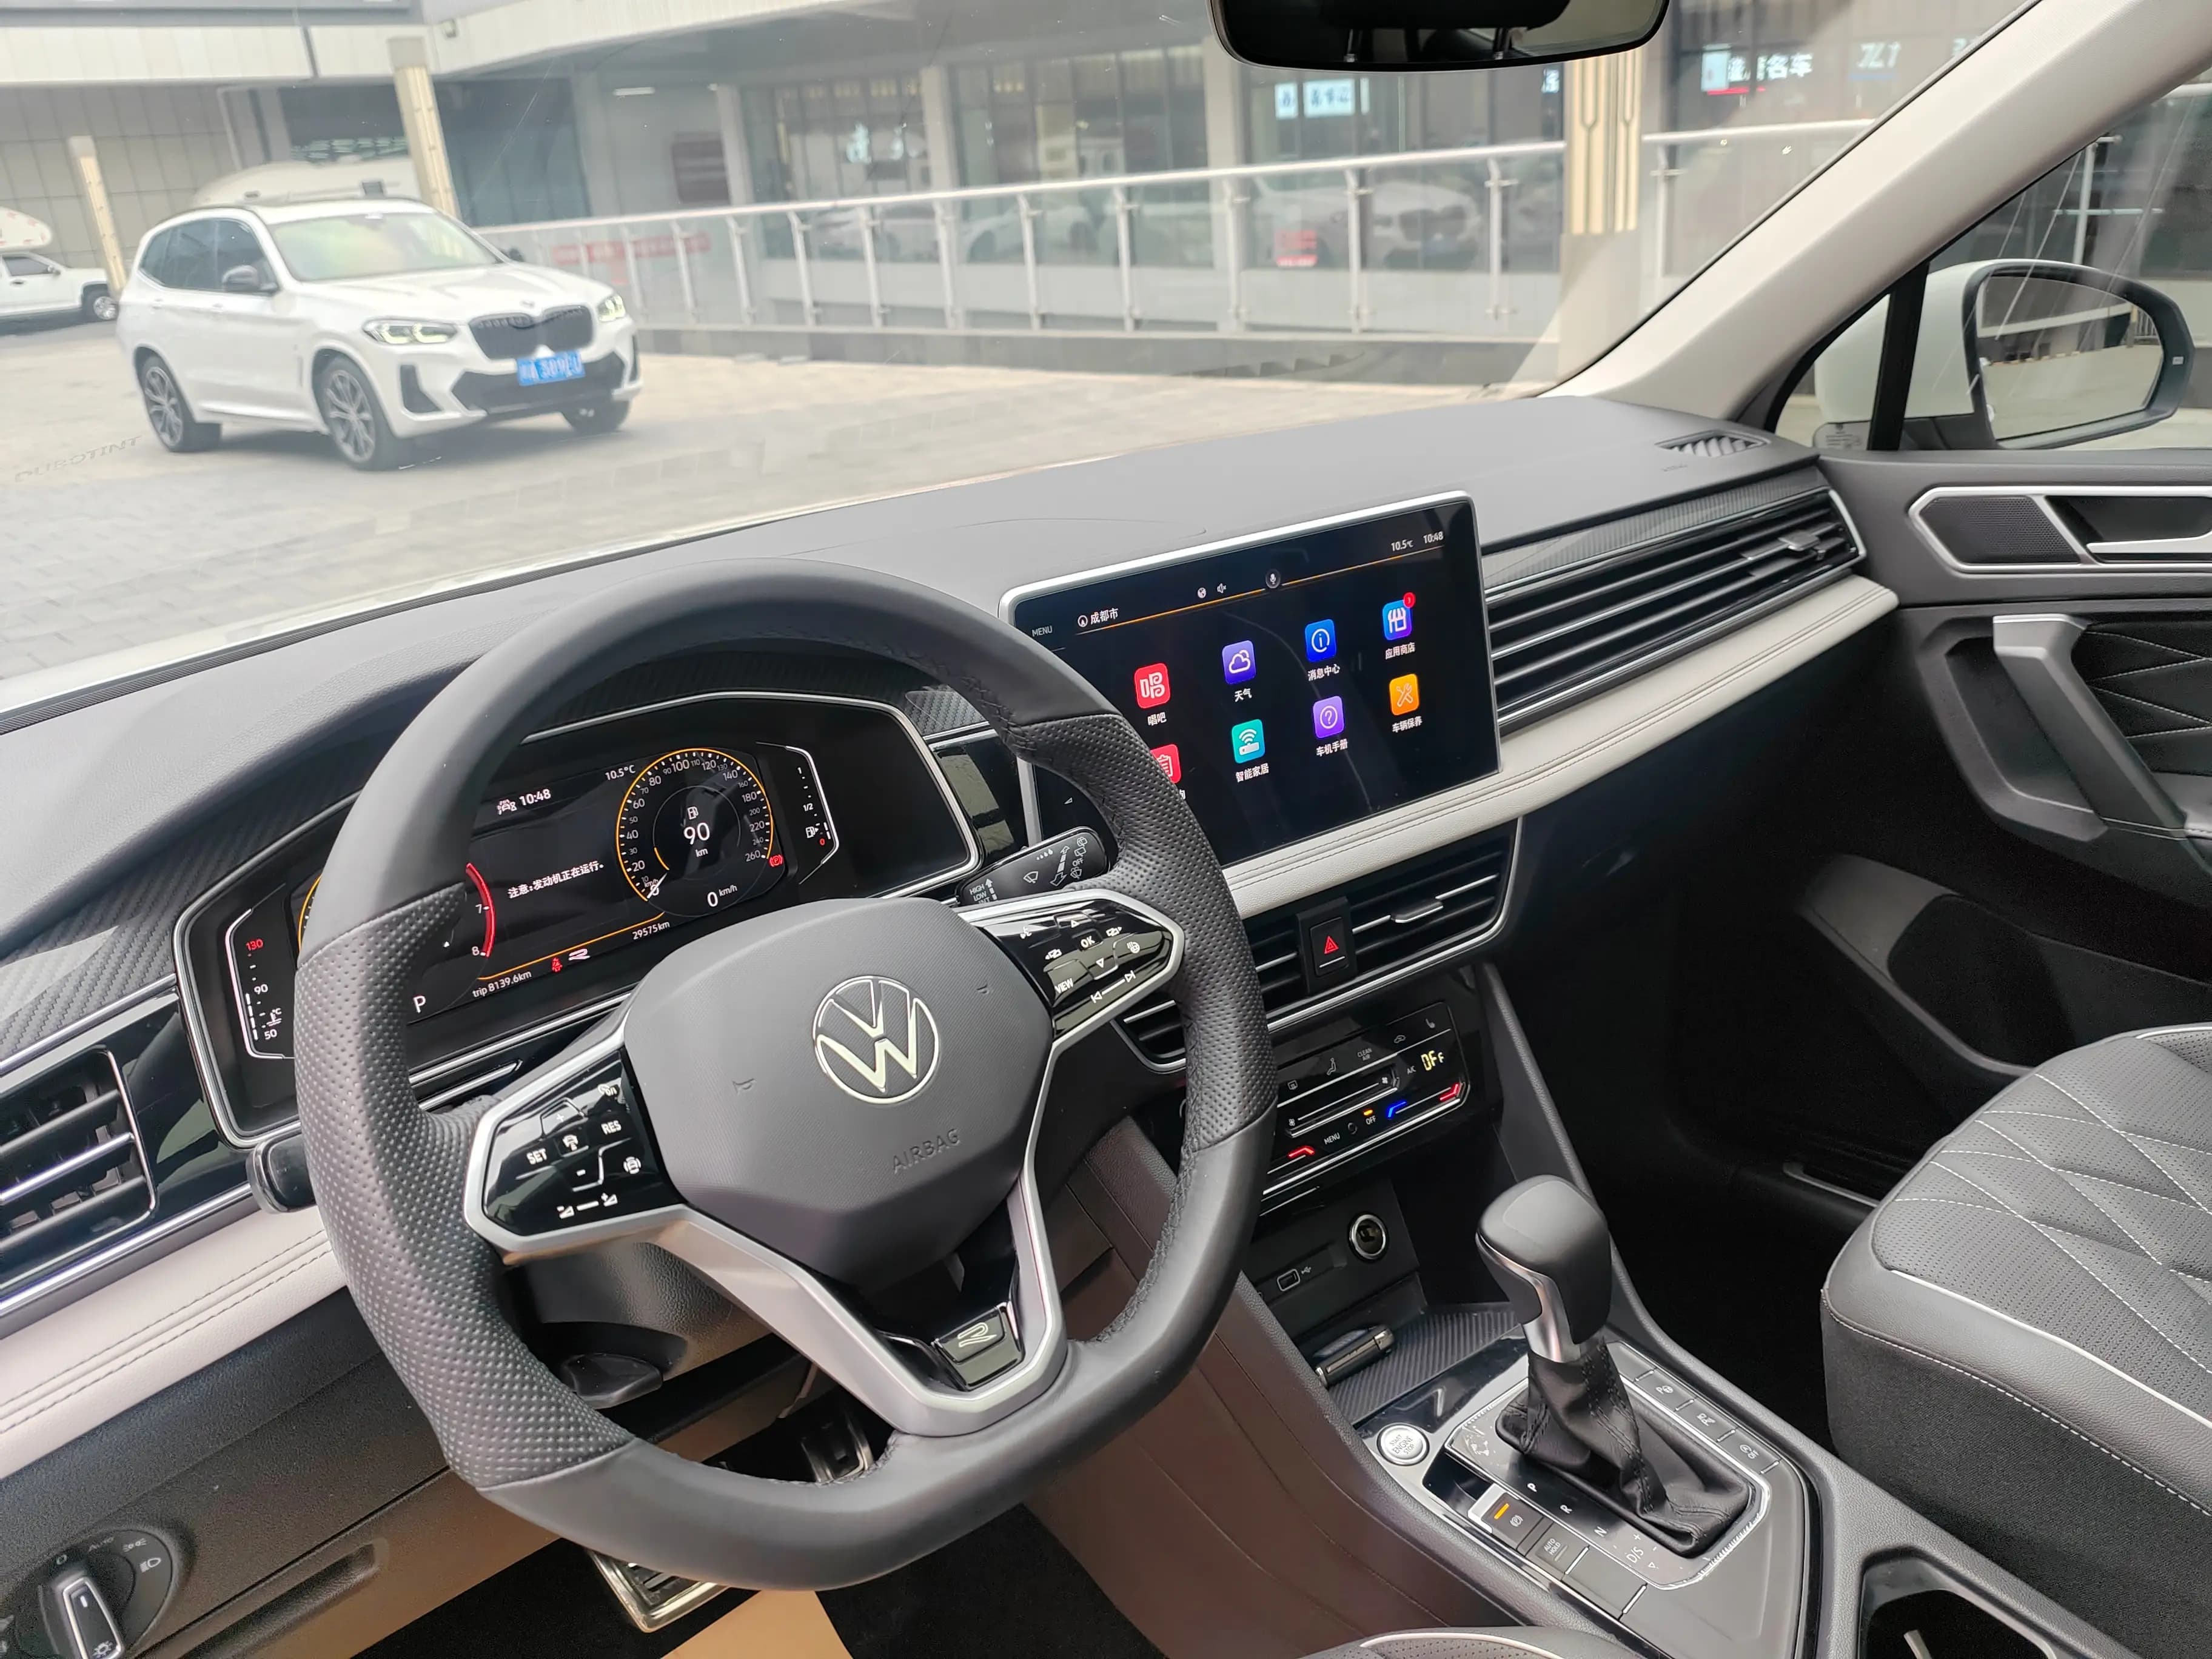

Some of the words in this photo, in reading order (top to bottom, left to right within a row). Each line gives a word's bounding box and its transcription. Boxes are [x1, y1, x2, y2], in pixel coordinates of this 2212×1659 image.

[1423, 530, 1444, 545] 10:48
[1090, 608, 1119, 625] 成都市
[1031, 624, 1053, 637] MENU
[1385, 642, 1415, 660] 应用商店
[1307, 663, 1341, 682] 消息中心
[1234, 687, 1252, 703] 天气
[1147, 711, 1167, 727] 唱吧
[1392, 714, 1423, 734] 车辆保养
[1316, 738, 1348, 758] 车机手册
[662, 766, 672, 775] 90
[671, 759, 689, 772] 100
[702, 760, 717, 771] 120
[717, 763, 728, 771] 130
[605, 764, 636, 782] 10.5°C
[723, 769, 738, 780] 140
[1235, 762, 1269, 783] 智能家居
[649, 776, 662, 786] 80
[739, 780, 748, 789] 160
[519, 788, 551, 806] 10:48
[742, 791, 757, 803] 180
[632, 799, 645, 809] 60
[803, 802, 813, 811] 1/2
[749, 807, 760, 816] 200
[749, 821, 765, 833] 220
[626, 830, 638, 840] 40
[683, 822, 710, 845] 90
[752, 837, 764, 845] 240
[695, 847, 708, 857] km
[745, 851, 760, 862] 260
[632, 860, 645, 871] 20
[1073, 857, 1084, 866] OFF
[970, 883, 985, 895] HIGH
[707, 891, 718, 907] 0
[719, 885, 737, 897] km/h
[973, 891, 987, 902] LOW
[475, 903, 483, 914] 7
[246, 939, 263, 951] 130
[1081, 936, 1095, 948] OK
[472, 946, 480, 956] 8
[254, 984, 269, 994] 90
[1054, 977, 1074, 994] VIEW
[472, 986, 488, 999] trip
[412, 994, 427, 1013] P
[264, 1029, 277, 1039] 50
[1357, 1048, 1372, 1059] CLEAN
[1407, 1065, 1416, 1075] A/C
[1366, 1116, 1376, 1125] OFF
[600, 1120, 622, 1135] RES
[1324, 1133, 1340, 1145] MENU
[526, 1148, 547, 1165] SET
[892, 1127, 962, 1175] AIRBAG
[1392, 1436, 1413, 1455] ENGINE
[1404, 1444, 1416, 1455] STOP
[1527, 1483, 1537, 1492] P
[1560, 1504, 1573, 1514] R
[1594, 1526, 1607, 1537] N
[1544, 1538, 1556, 1552] AUTO
[1549, 1542, 1561, 1555] HOLD
[1626, 1547, 1644, 1563] D/S
